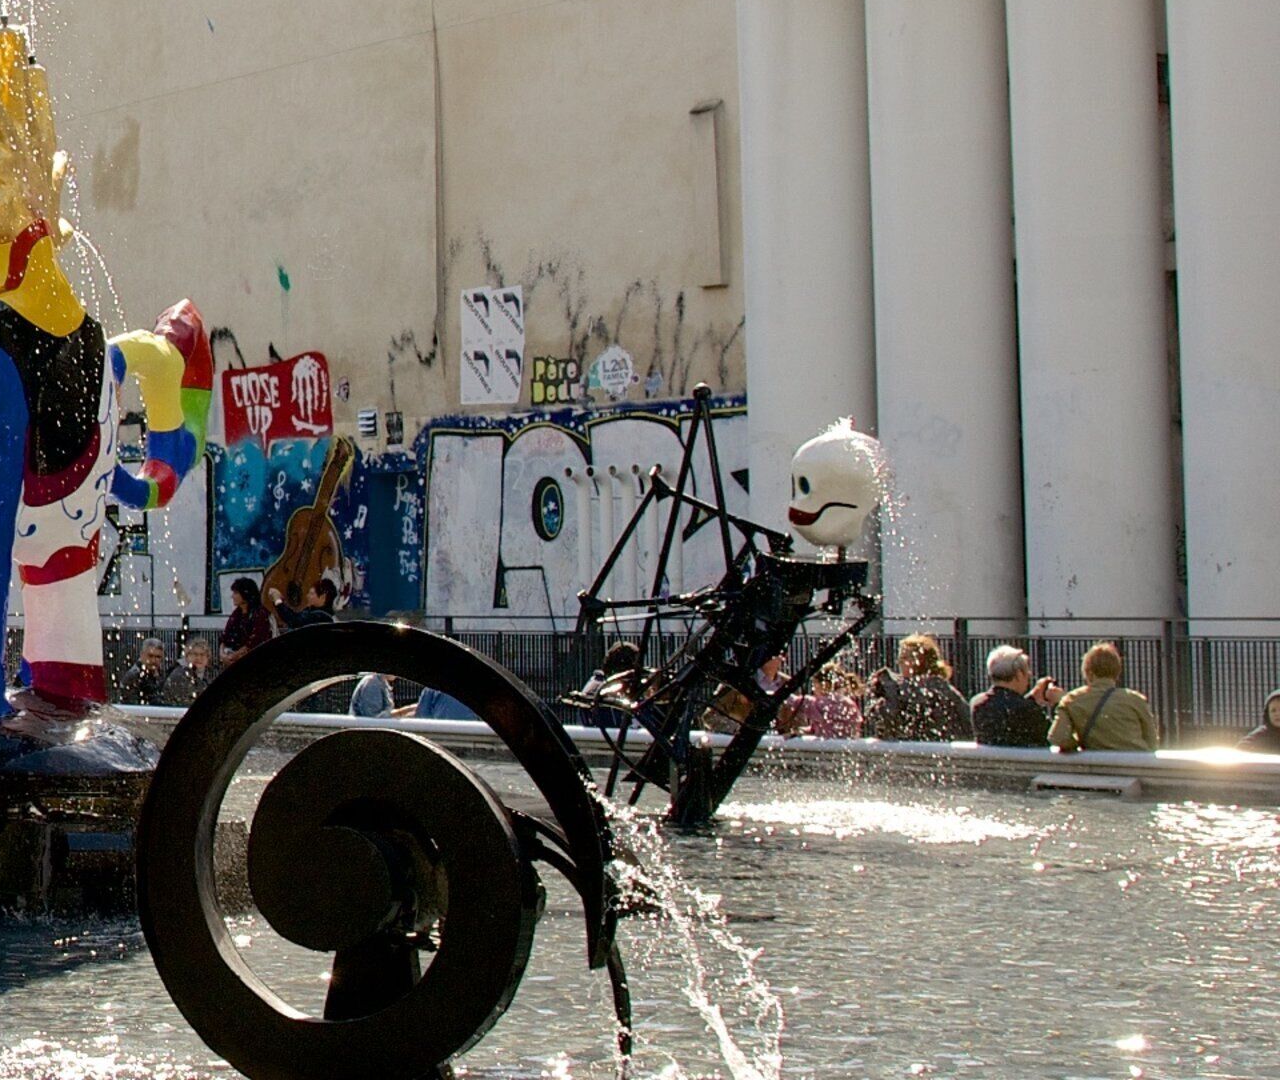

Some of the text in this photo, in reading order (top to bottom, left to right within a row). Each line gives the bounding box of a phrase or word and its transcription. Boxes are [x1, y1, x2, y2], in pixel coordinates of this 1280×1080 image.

[493, 295, 523, 335] INDUSTRIES
[230, 372, 280, 408] CLOSE
[463, 351, 492, 394] INDUSTRIES
[246, 406, 273, 435] UP
